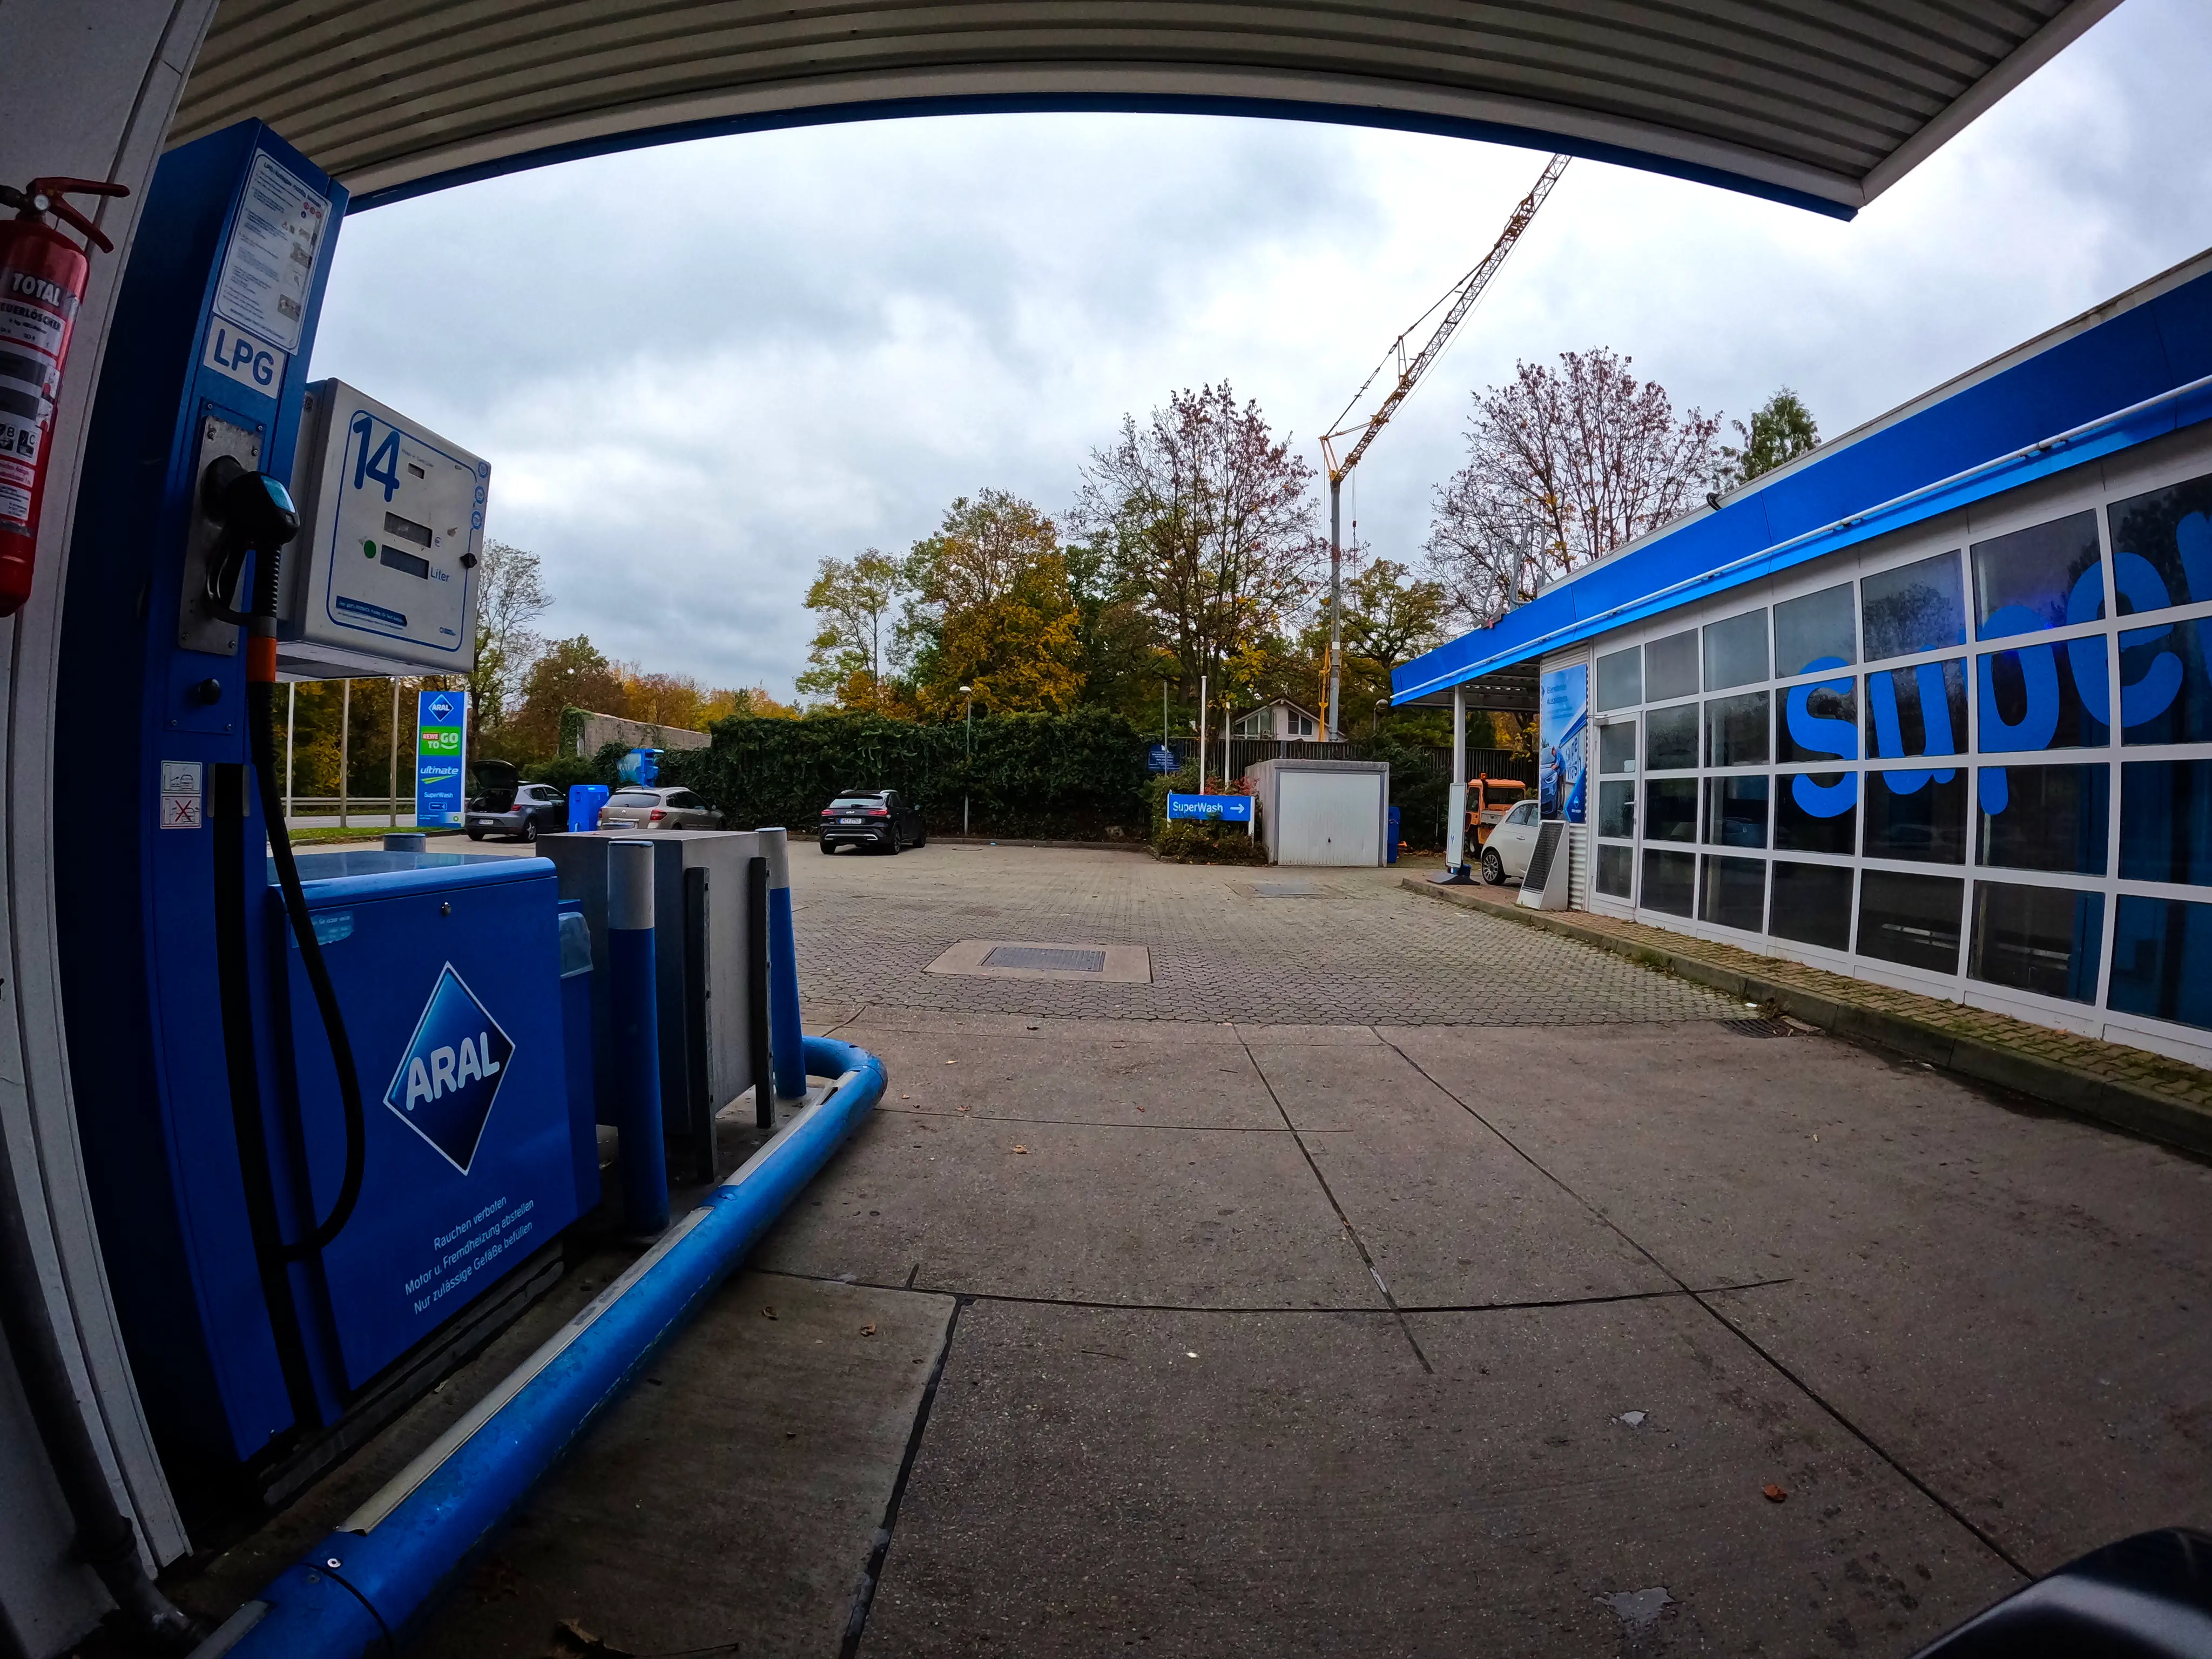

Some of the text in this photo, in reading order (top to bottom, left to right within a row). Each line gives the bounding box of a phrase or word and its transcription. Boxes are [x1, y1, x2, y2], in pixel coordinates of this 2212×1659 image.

[13, 273, 60, 307] TOTAL
[214, 328, 274, 386] LPG
[353, 416, 401, 503] 14
[430, 567, 449, 583] Liter
[428, 741, 440, 749] TO
[440, 732, 458, 744] GO
[420, 766, 458, 774] ultimate
[1172, 801, 1223, 814] SuperWash
[406, 1031, 500, 1111] ARAL
[434, 1196, 507, 1251] Rauchen verboten
[405, 1199, 534, 1295] Motor u. Fremdheizung abstellen
[414, 1221, 533, 1314] Nur zulässige Gefäße befüllen
